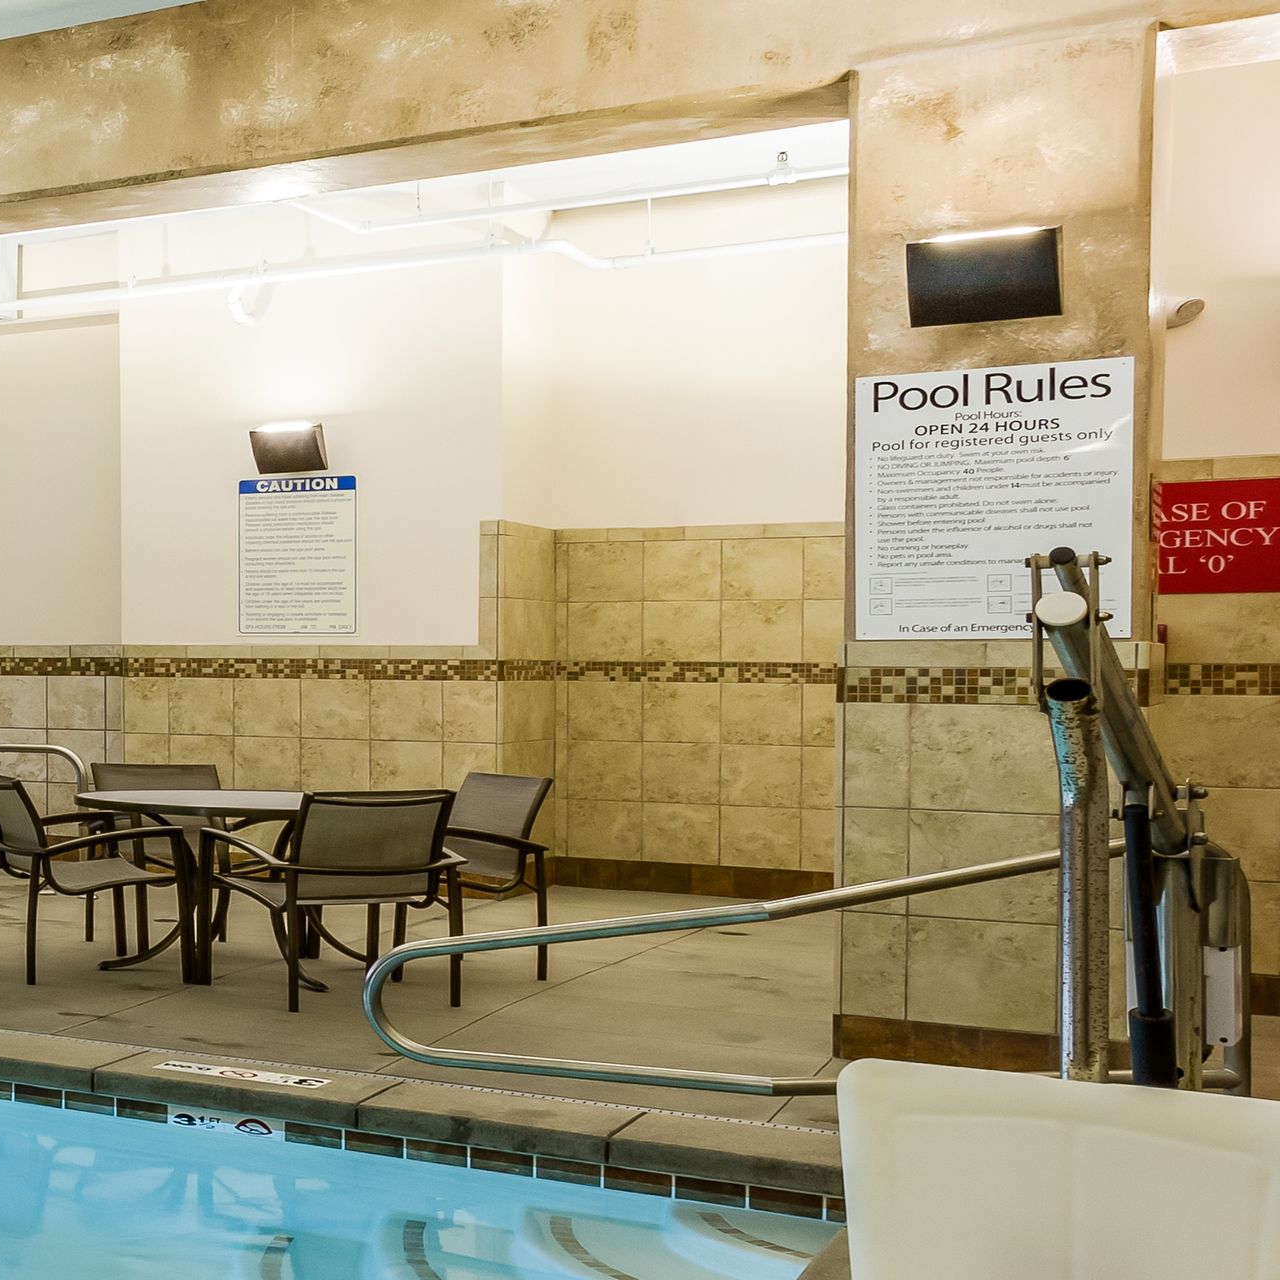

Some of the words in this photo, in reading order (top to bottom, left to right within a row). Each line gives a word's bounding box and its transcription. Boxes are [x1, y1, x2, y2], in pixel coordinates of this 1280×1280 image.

[872, 373, 970, 413] Pool
[984, 367, 1112, 406] Rules
[955, 411, 981, 421] Pool
[984, 409, 1023, 420] Hours:
[914, 422, 964, 436] OPEN
[968, 421, 990, 434] 24
[995, 417, 1060, 432] HOURS
[872, 440, 905, 452] Pool
[910, 438, 930, 449] for
[935, 434, 1014, 450] registered
[1019, 431, 1072, 446] guests
[1077, 428, 1113, 441] only
[889, 454, 923, 463] lifeguard
[991, 449, 1010, 457] your
[891, 462, 919, 470] DIVING
[1016, 456, 1035, 464] pool
[1035, 455, 1061, 463] depth
[915, 477, 968, 485] management
[983, 473, 1031, 482] responsible
[1043, 470, 1082, 479] accidents
[917, 469, 960, 477] Occupancy
[256, 478, 339, 493] CAUTION
[877, 487, 934, 495] Non-swimmers
[1054, 478, 1111, 487] accompanied
[894, 494, 937, 503] responsible
[926, 508, 984, 517] communicable
[985, 507, 1018, 515] diseases
[1019, 505, 1038, 513] shall
[1221, 501, 1266, 519] OF
[932, 518, 966, 526] entering
[946, 525, 982, 533] influence
[1033, 523, 1057, 531] drugs
[1058, 521, 1077, 529] shall
[889, 545, 920, 553] running
[889, 553, 907, 561] pets
[916, 552, 934, 560] pool
[877, 561, 903, 569] Report
[1158, 556, 1187, 575] L
[899, 624, 909, 633] In
[912, 623, 939, 633] Case
[940, 623, 952, 633] of
[953, 625, 969, 633] an
[970, 623, 1033, 635] Emergency
